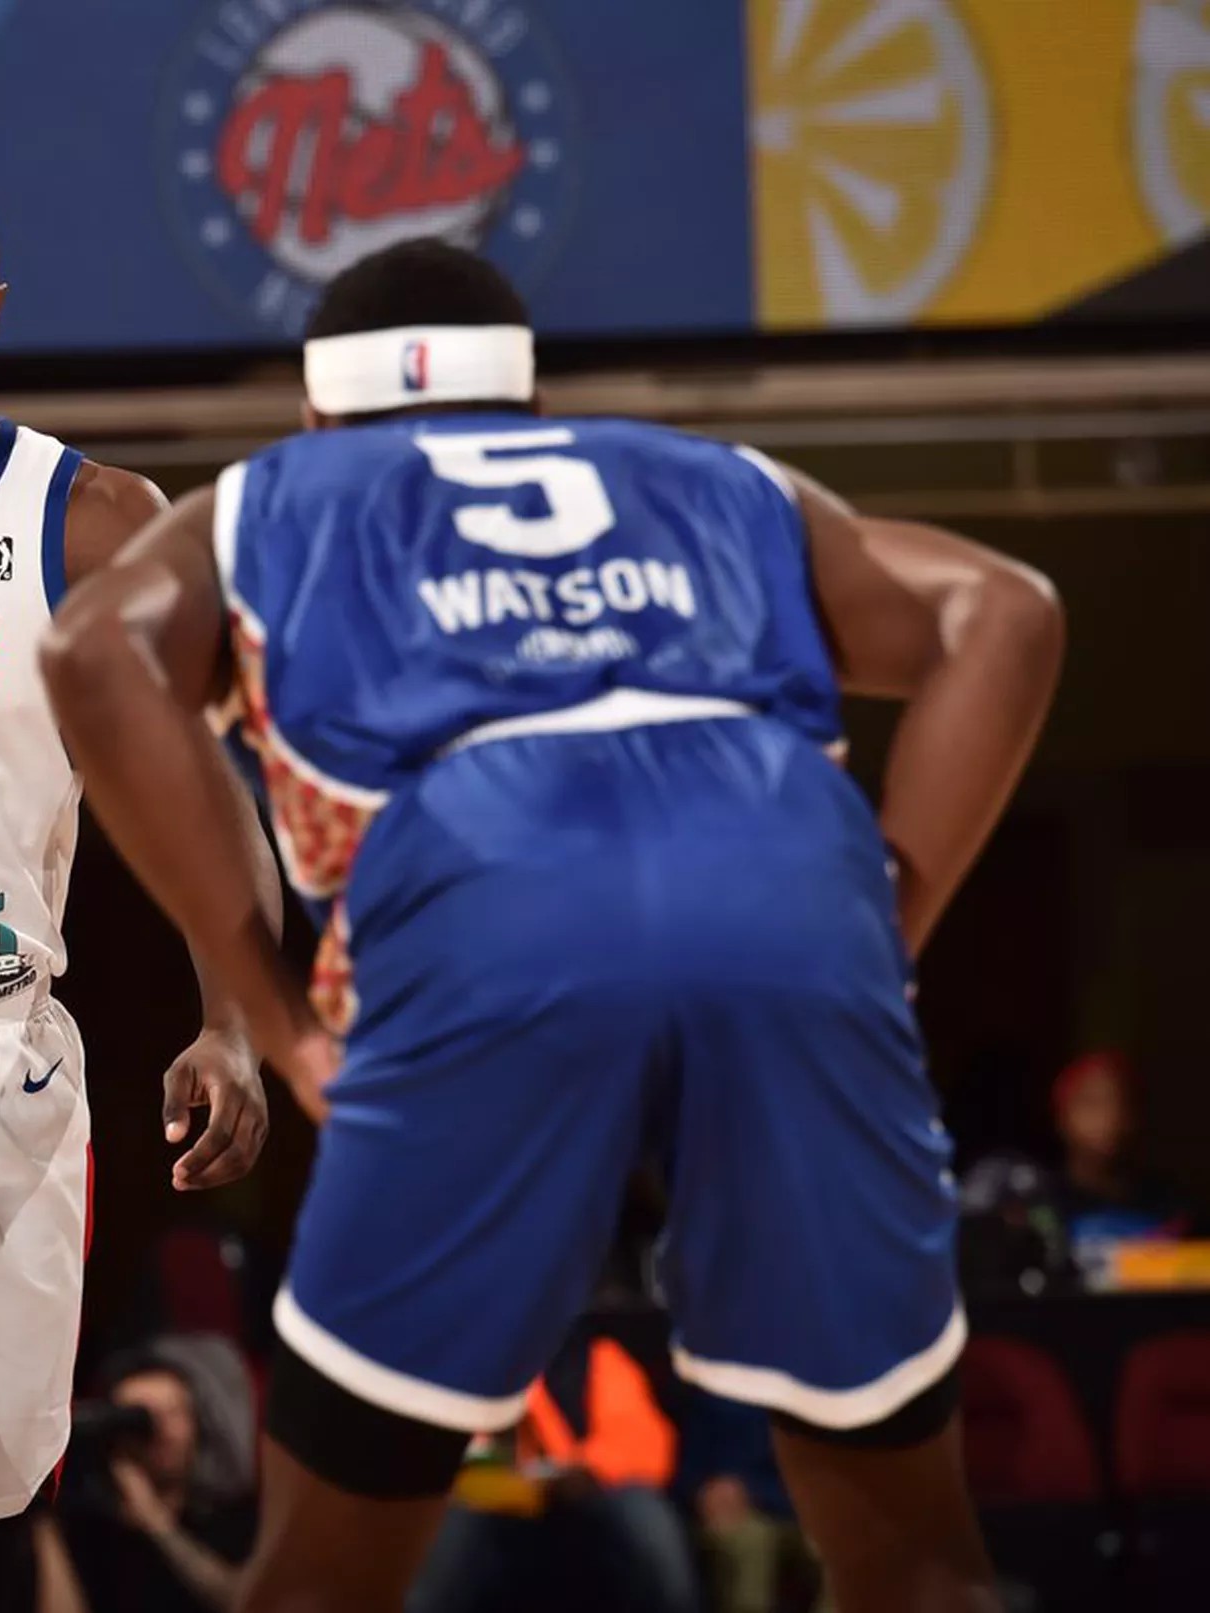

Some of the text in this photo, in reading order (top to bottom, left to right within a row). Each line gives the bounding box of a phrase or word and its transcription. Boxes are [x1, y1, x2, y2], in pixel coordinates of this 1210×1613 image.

[216, 40, 526, 248] Nets
[414, 428, 616, 558] 5
[419, 558, 697, 634] WATSON
